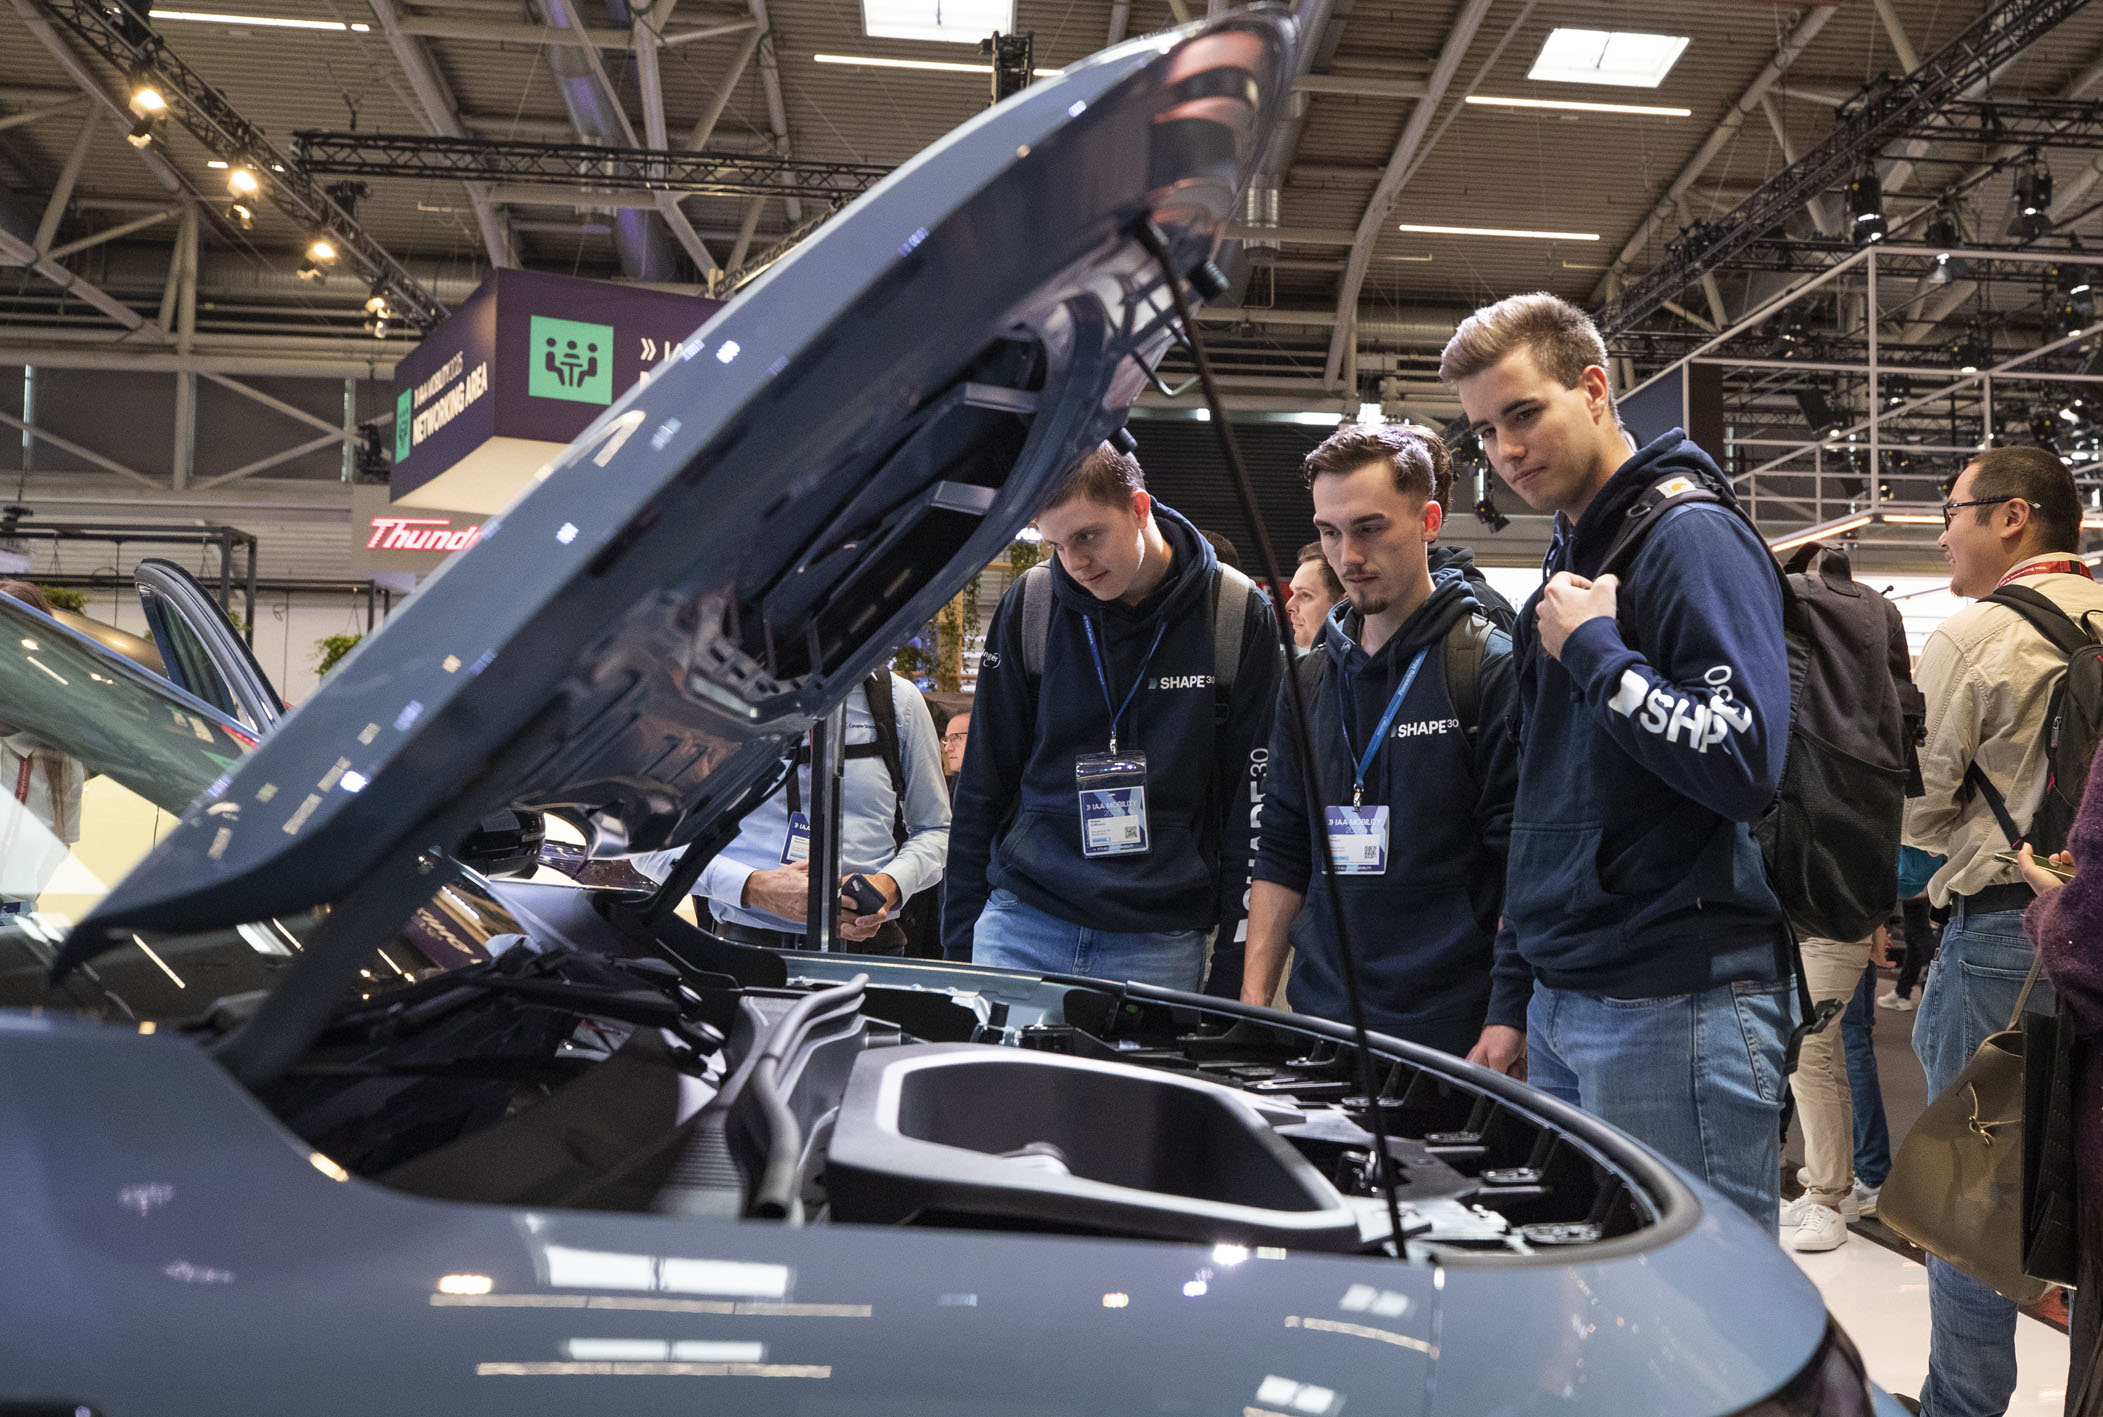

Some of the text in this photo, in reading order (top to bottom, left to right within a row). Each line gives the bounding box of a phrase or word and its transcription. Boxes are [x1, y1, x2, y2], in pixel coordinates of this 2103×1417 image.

[412, 361, 488, 447] NETWORKING AREA
[366, 516, 481, 551] Thund
[1398, 719, 1459, 738] SHAPE30
